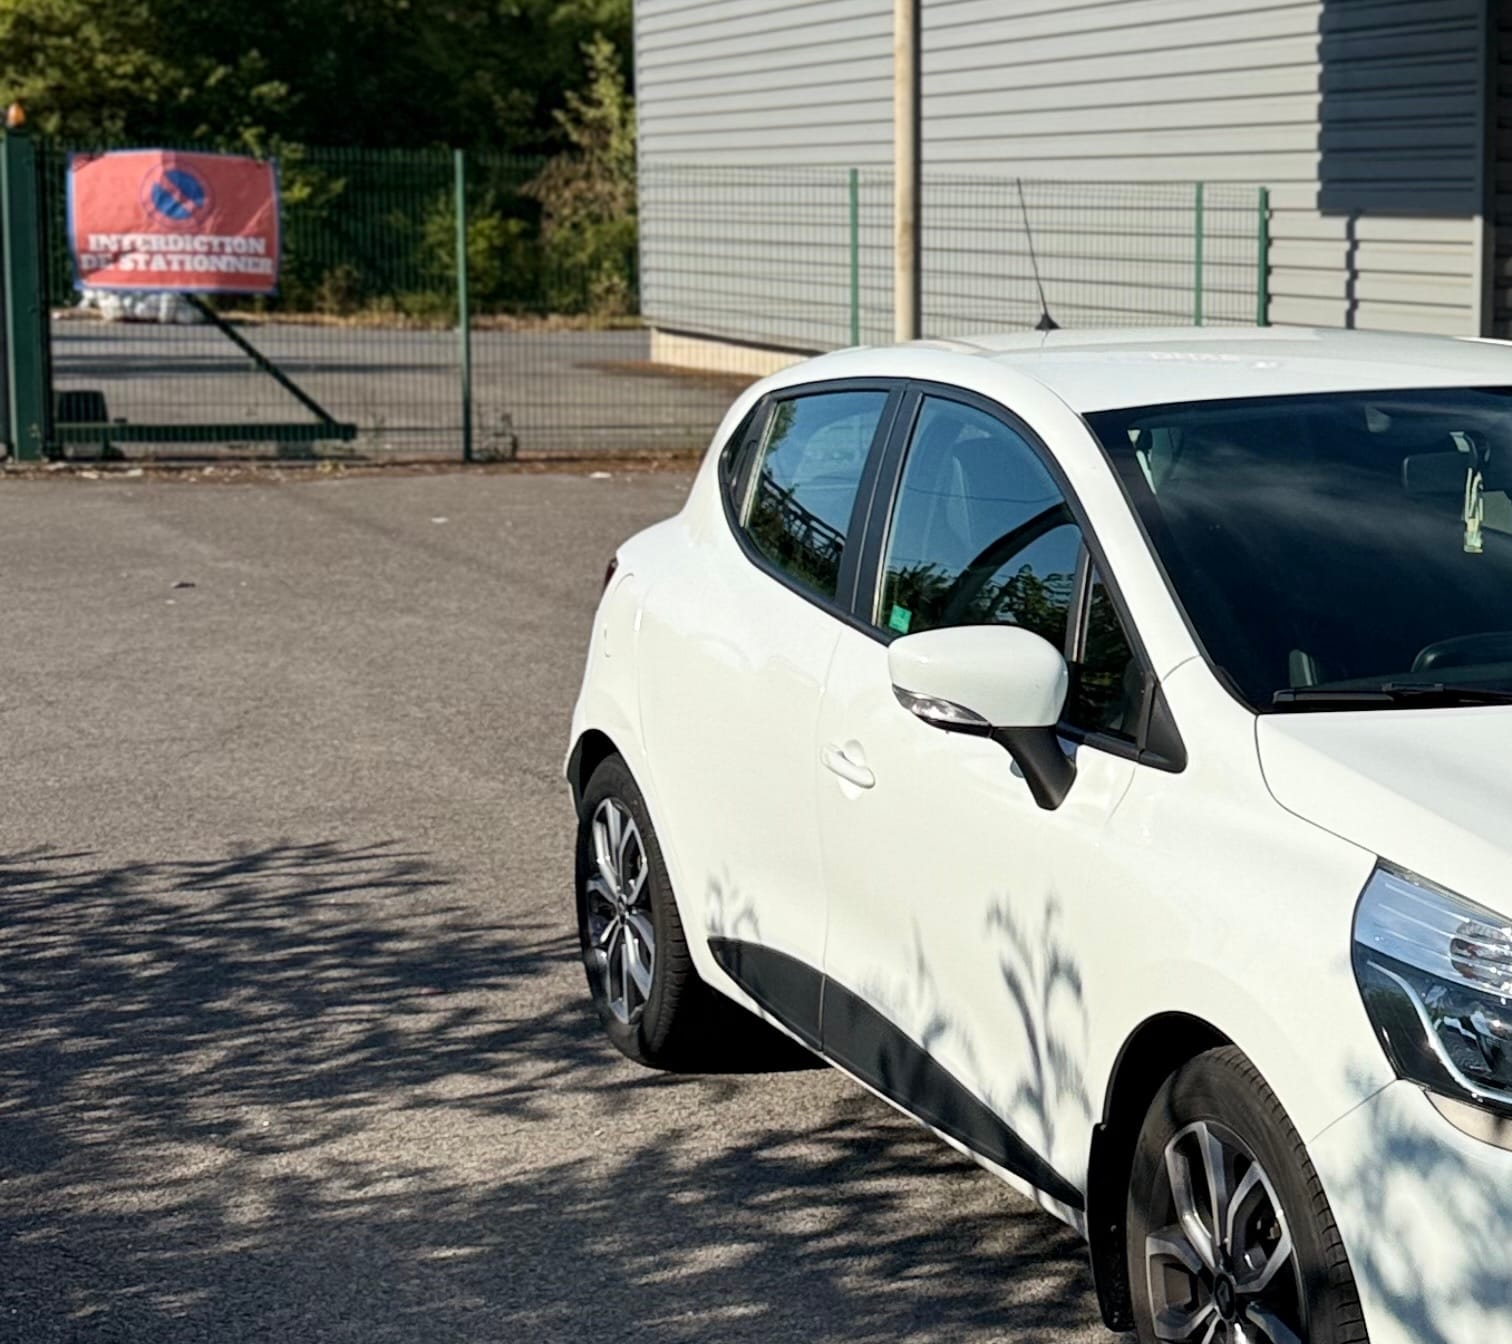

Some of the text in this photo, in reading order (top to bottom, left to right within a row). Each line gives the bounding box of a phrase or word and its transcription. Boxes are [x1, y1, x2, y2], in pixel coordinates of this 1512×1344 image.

[88, 233, 266, 255] INTERDICTION
[81, 252, 273, 275] DE STATIONNER
